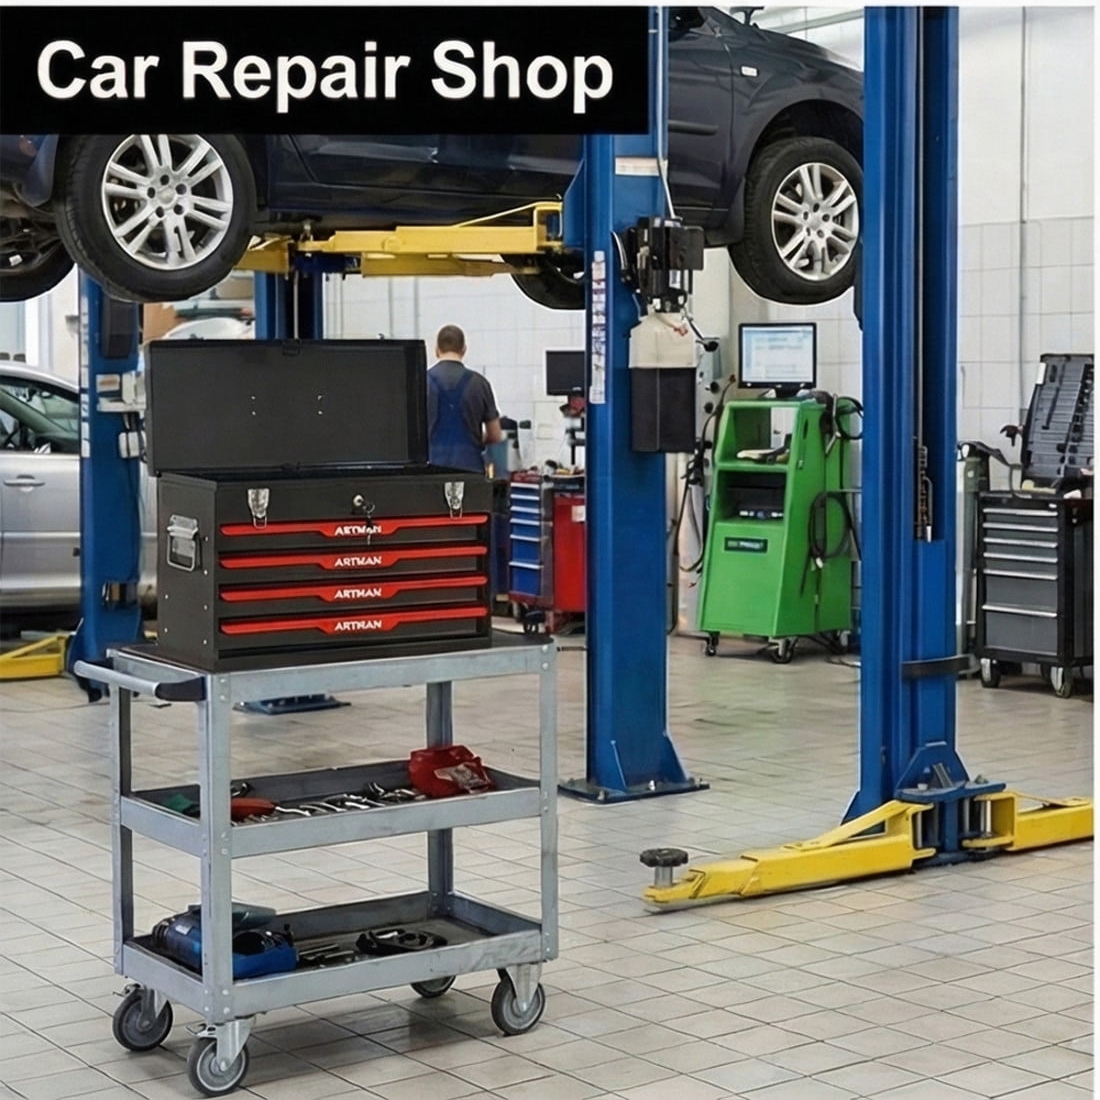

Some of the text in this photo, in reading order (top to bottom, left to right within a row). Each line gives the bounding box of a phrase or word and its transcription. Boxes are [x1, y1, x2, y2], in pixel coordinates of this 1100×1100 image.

[333, 555, 382, 568] ARTMAN
[333, 587, 382, 600] ARTMAN
[333, 619, 382, 632] ARTMAN
